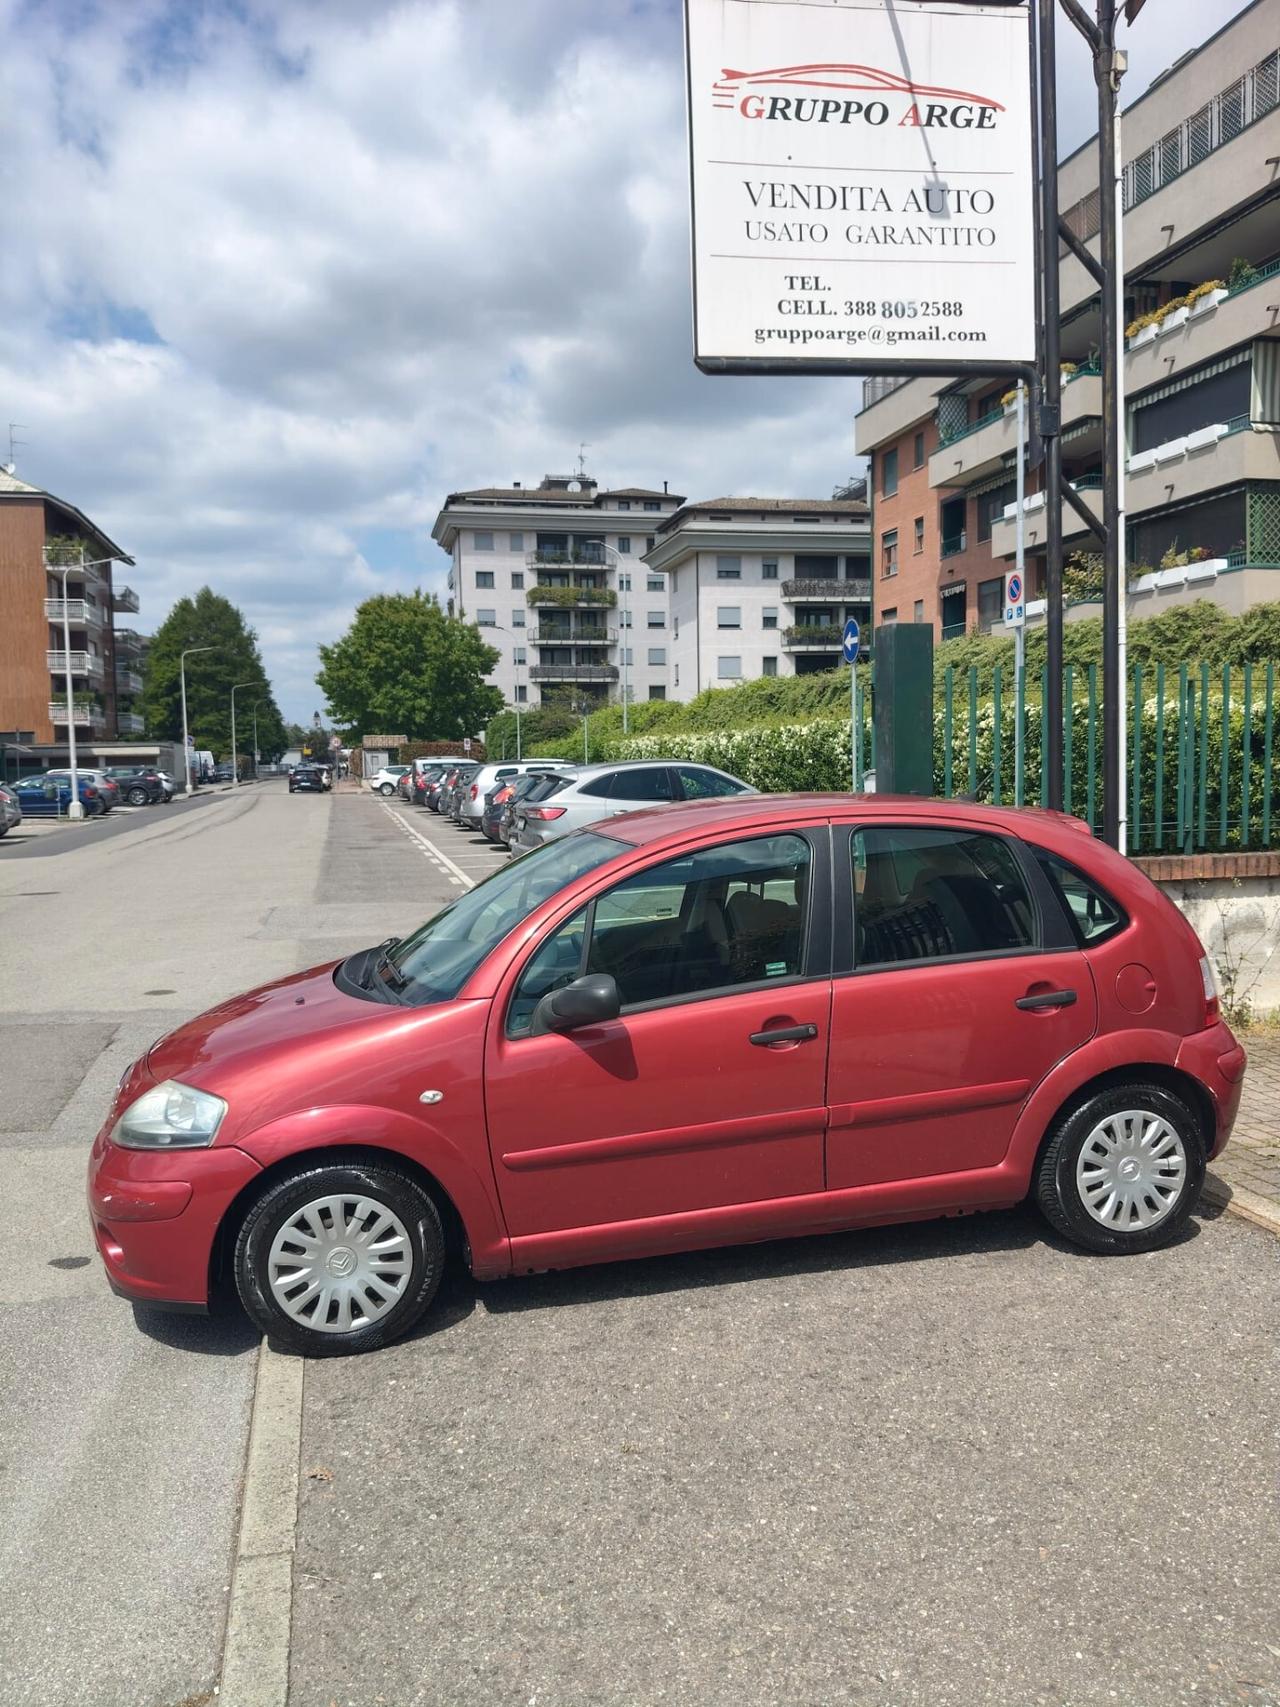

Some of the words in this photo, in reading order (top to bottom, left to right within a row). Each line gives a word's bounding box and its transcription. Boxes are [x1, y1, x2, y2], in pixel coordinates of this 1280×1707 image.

[740, 95, 889, 126] GRUPPO
[898, 103, 998, 130] ARGE
[743, 181, 893, 212] VENDITA
[902, 188, 995, 215] AUTO
[744, 221, 828, 243] USATO
[846, 225, 996, 247] GARANTITO
[784, 275, 832, 292] TEL.
[777, 299, 838, 316] CELL.
[754, 325, 988, 346] gruppoarge@gmail.com
